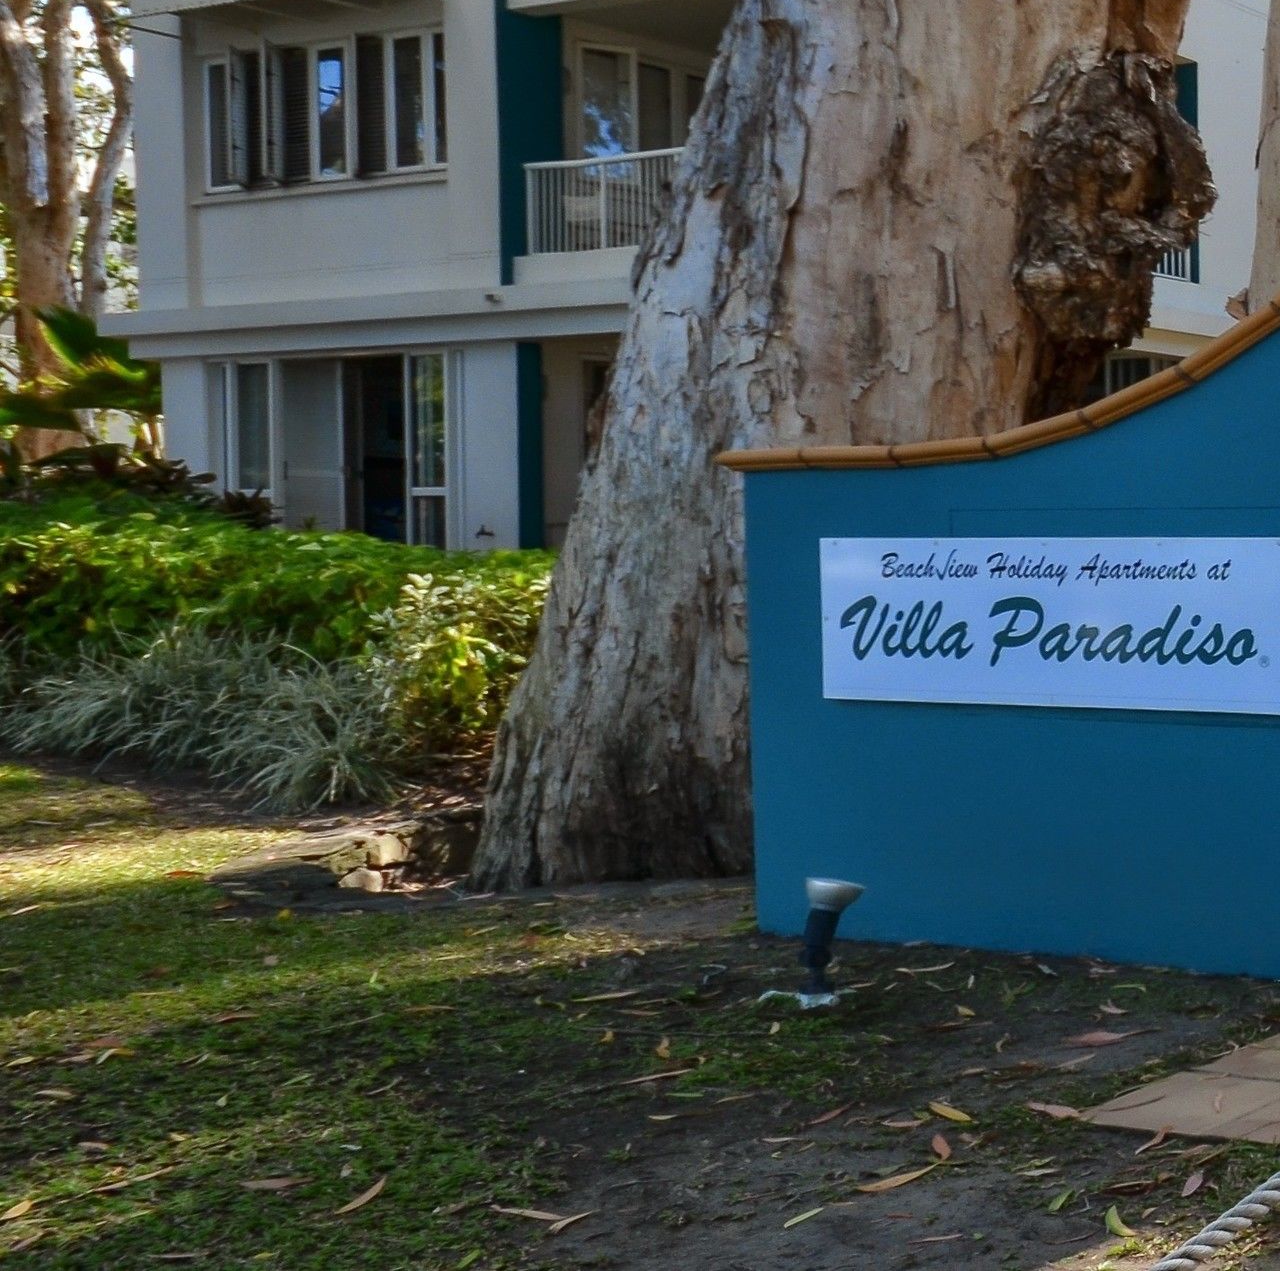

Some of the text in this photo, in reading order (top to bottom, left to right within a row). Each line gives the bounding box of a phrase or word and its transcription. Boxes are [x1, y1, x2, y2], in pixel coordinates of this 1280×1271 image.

[881, 549, 1232, 587] BeachView Holiday Apartments at
[840, 594, 1259, 667] Villa Paradiso
